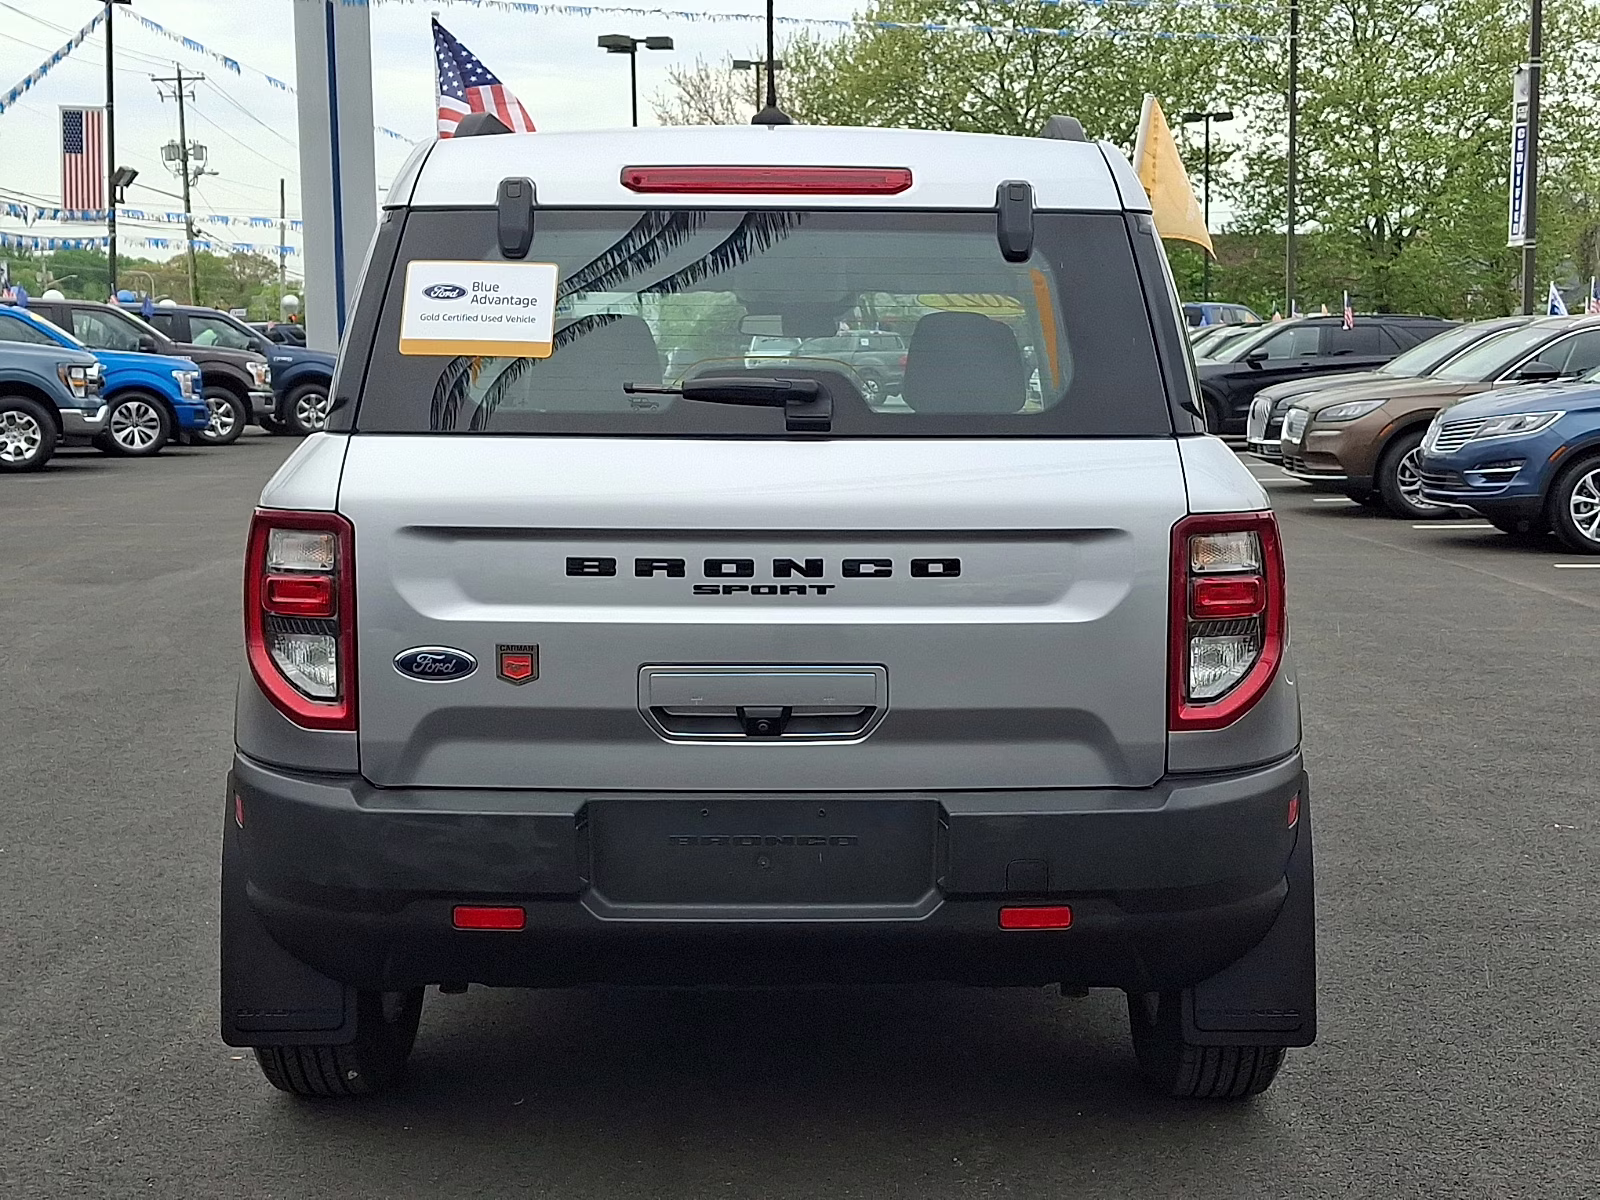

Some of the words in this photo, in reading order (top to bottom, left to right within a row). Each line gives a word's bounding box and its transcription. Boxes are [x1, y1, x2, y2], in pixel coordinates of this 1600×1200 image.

[1512, 127, 1526, 234] CERTIFIED
[430, 286, 460, 298] Ford
[472, 281, 500, 293] Blue
[470, 294, 538, 308] Advantage
[420, 313, 440, 322] Gold
[442, 313, 478, 322] Certified
[481, 314, 503, 323] Used
[506, 315, 536, 324] Vehicle
[565, 556, 961, 577] BRONCO
[692, 584, 836, 595] SPORT
[412, 653, 456, 673] Ford
[669, 834, 858, 847] BRONCO
